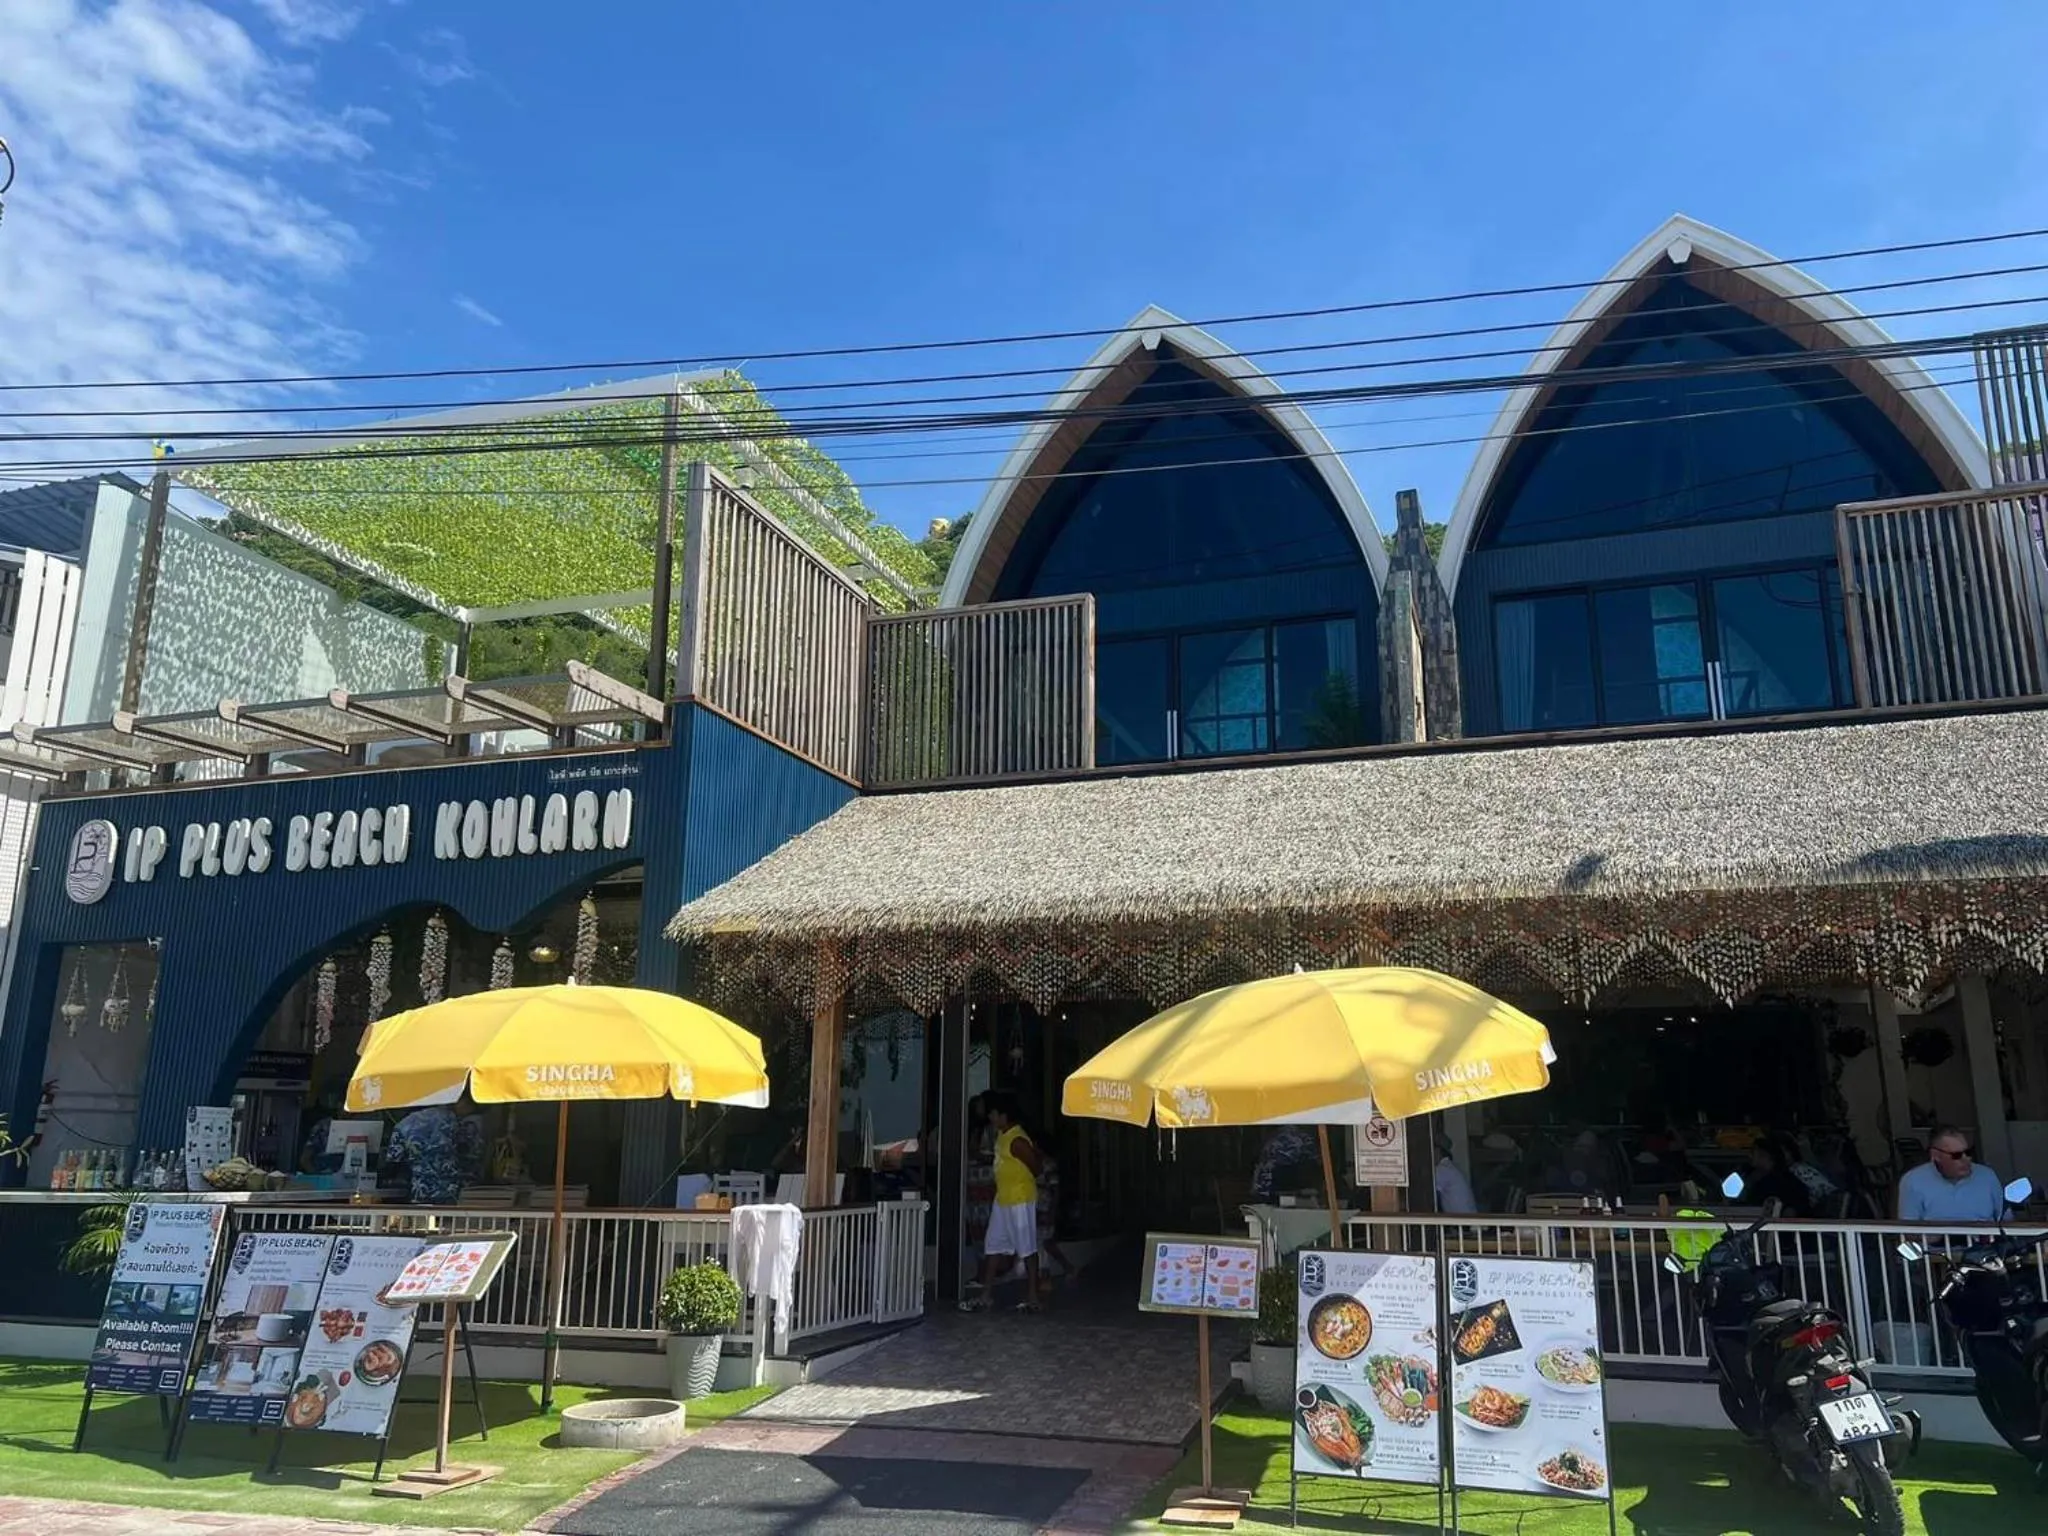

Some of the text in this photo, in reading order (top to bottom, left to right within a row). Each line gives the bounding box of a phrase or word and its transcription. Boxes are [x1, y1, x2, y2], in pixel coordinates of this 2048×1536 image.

[124, 788, 632, 883] IP PLUS BEACH KOHLARN
[525, 1063, 616, 1082] SINGHA
[1415, 1060, 1493, 1091] SINGHA
[1090, 1080, 1133, 1102] SINGHA
[160, 1209, 182, 1220] PLUS
[184, 1210, 211, 1220] BEACH
[259, 1238, 327, 1248] IP PLUS BEACH
[102, 1319, 194, 1335] Available Room!!!!
[104, 1337, 182, 1353] Please Contact
